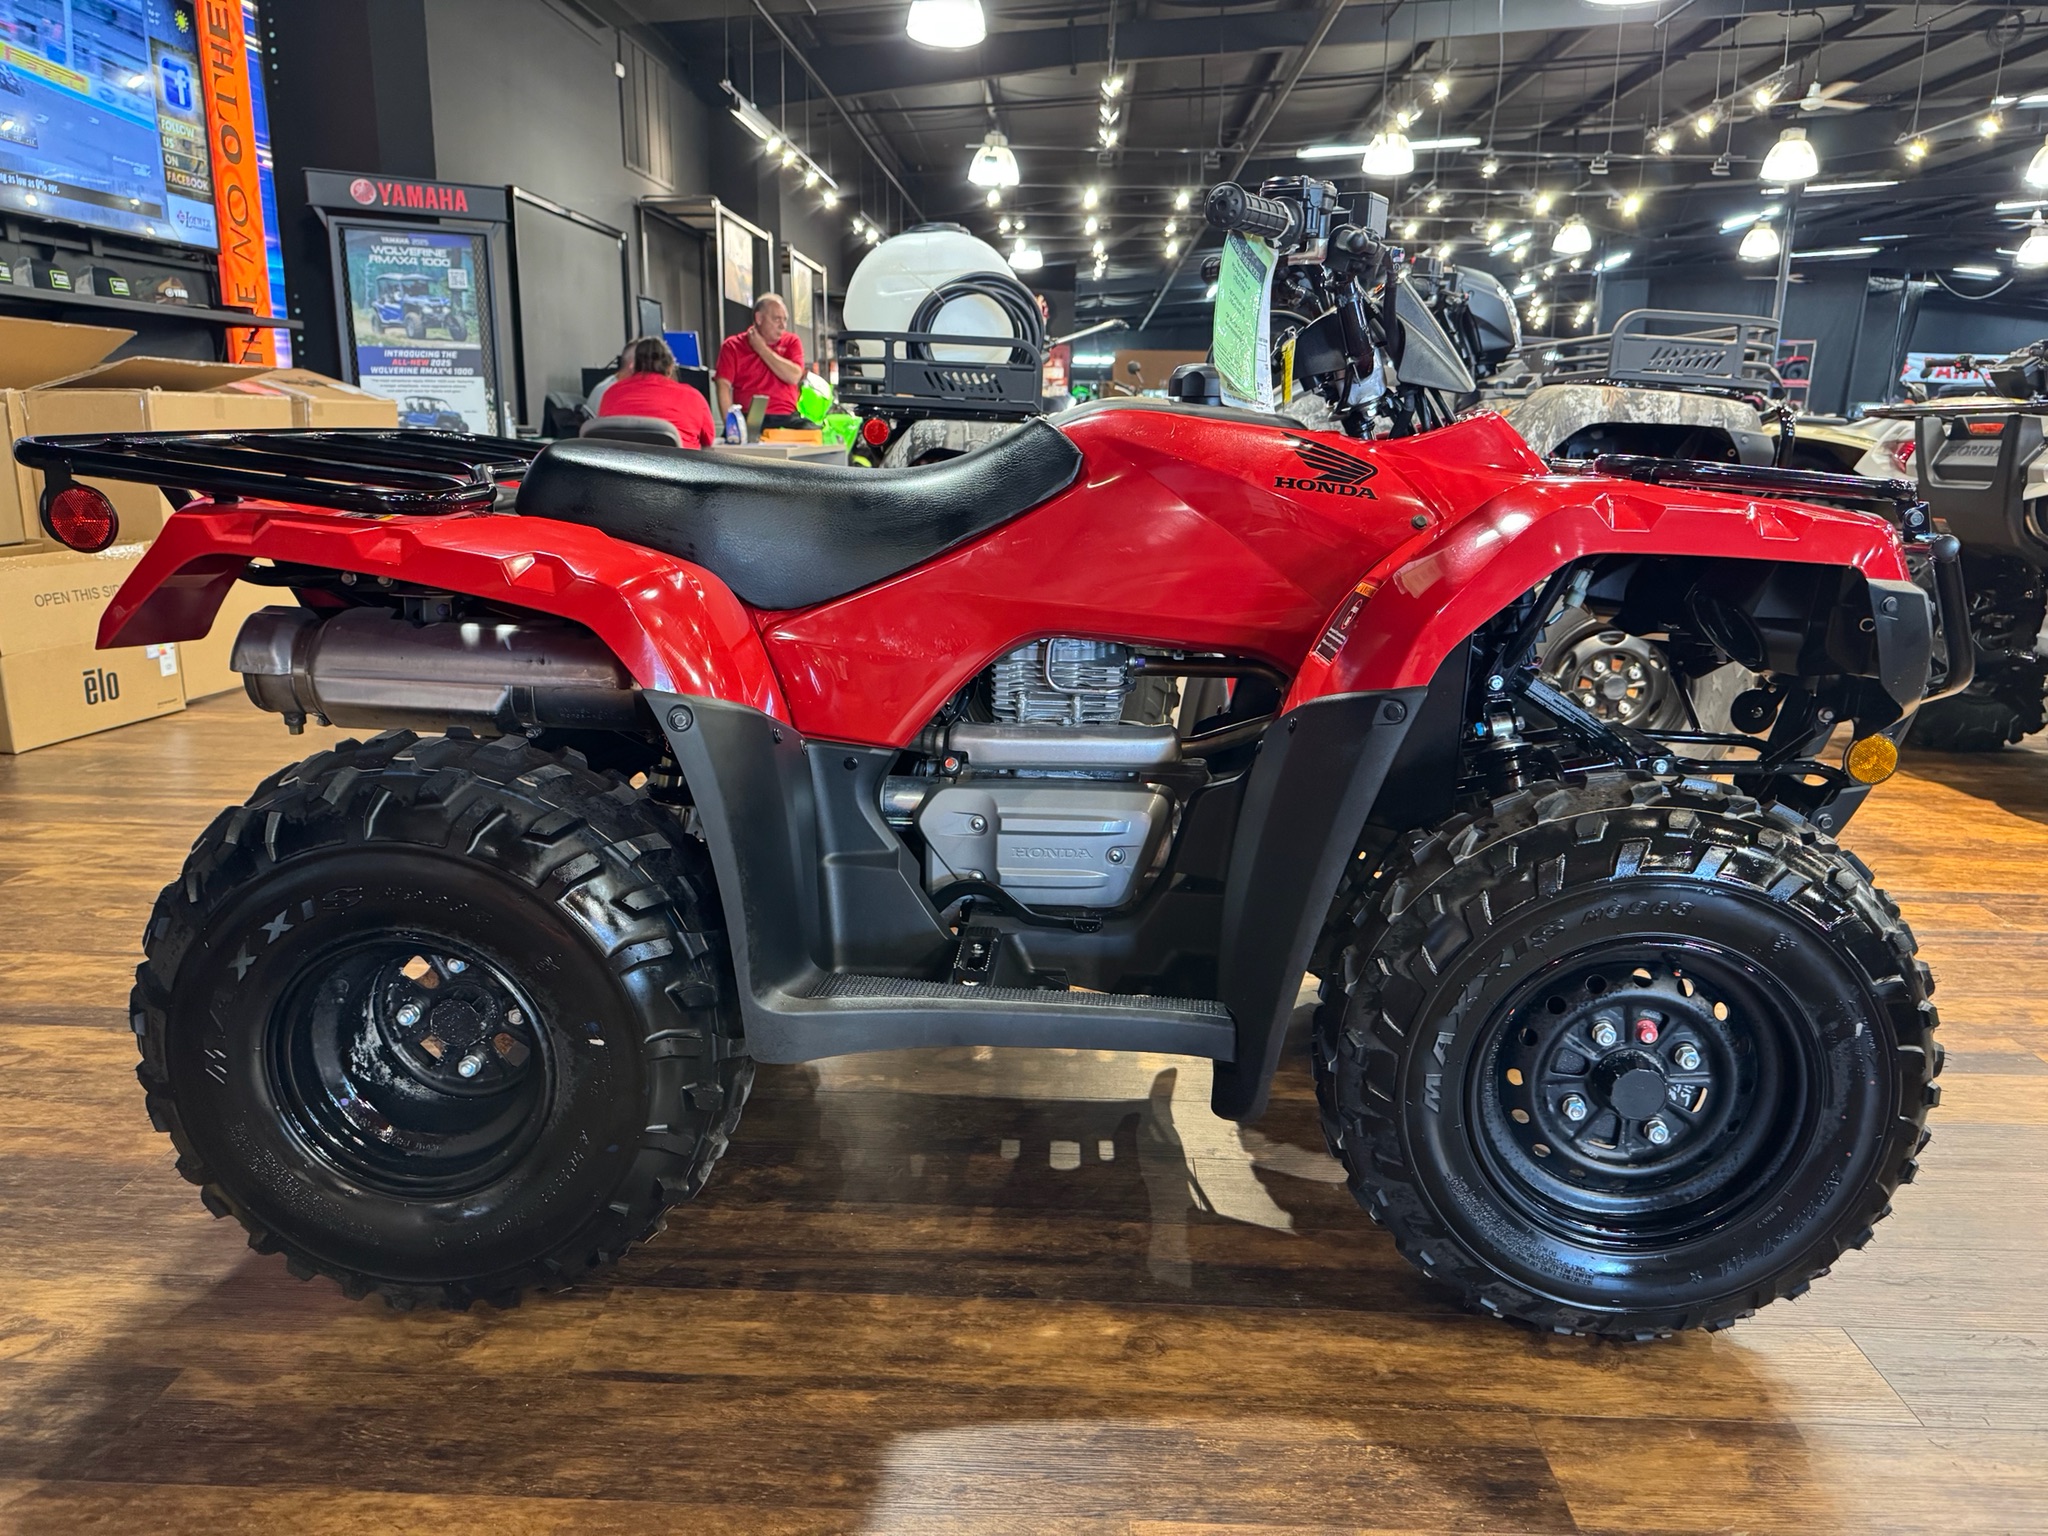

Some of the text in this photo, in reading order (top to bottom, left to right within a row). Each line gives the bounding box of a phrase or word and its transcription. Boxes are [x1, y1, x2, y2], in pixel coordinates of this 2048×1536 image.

[206, 0, 243, 165] OTHE
[161, 118, 195, 138] FOLLOW
[162, 136, 174, 149] US
[164, 154, 179, 167] ON
[166, 170, 210, 191] FACEBOOK
[378, 182, 468, 212] YAMAHA
[227, 184, 254, 264] NO
[380, 236, 410, 245] YAMAHA
[370, 245, 447, 258] WOLVERINE
[421, 257, 451, 268] 1000
[384, 349, 458, 359] INTRODUCING THE
[391, 358, 452, 367] ALL-NEW 2025
[370, 366, 418, 374] WOLVERINE
[454, 367, 474, 375] 1000
[1274, 476, 1379, 500] HONDA
[34, 584, 121, 607] OPEN THIS SID
[1011, 846, 1094, 859] HONDA
[1423, 918, 1567, 1114] MAXXIS
